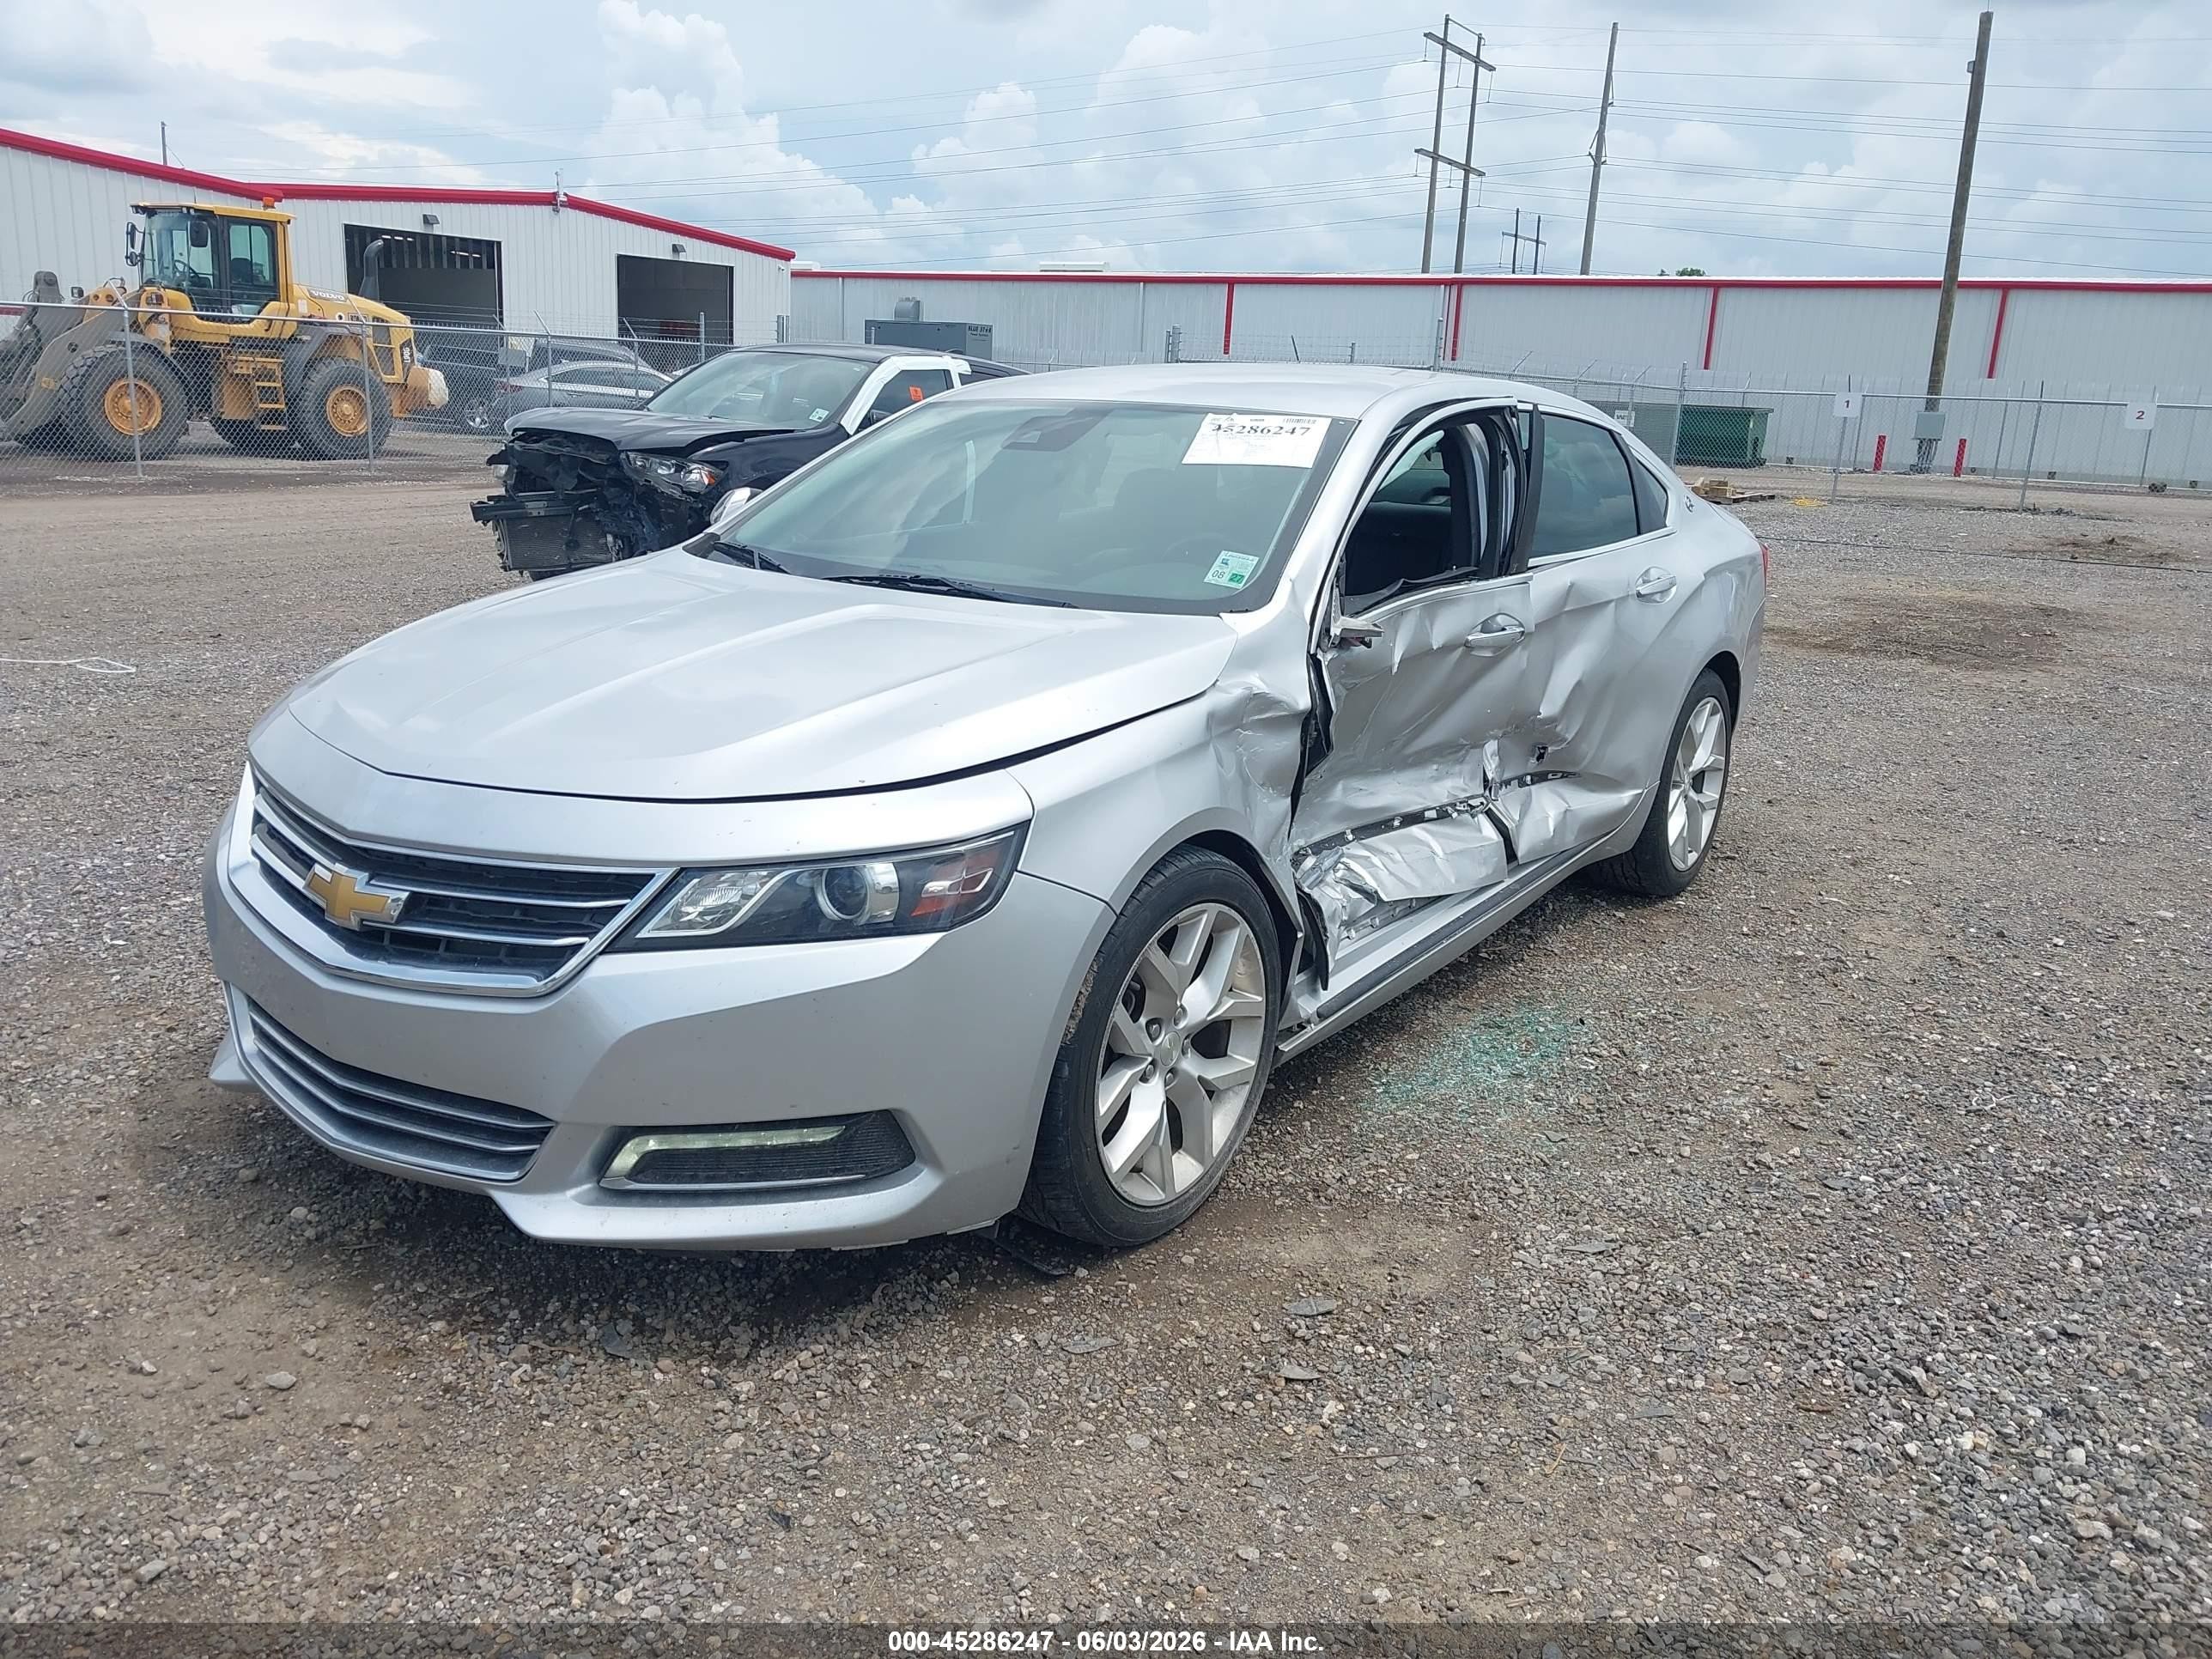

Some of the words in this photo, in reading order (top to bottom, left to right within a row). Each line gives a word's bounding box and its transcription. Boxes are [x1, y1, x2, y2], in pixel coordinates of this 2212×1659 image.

[310, 289, 344, 301] VOLVO
[1844, 399, 1850, 408] 1
[2136, 410, 2145, 420] 2
[1211, 423, 1311, 436] 45286247
[1212, 569, 1225, 579] 08
[1229, 573, 1245, 585] 27
